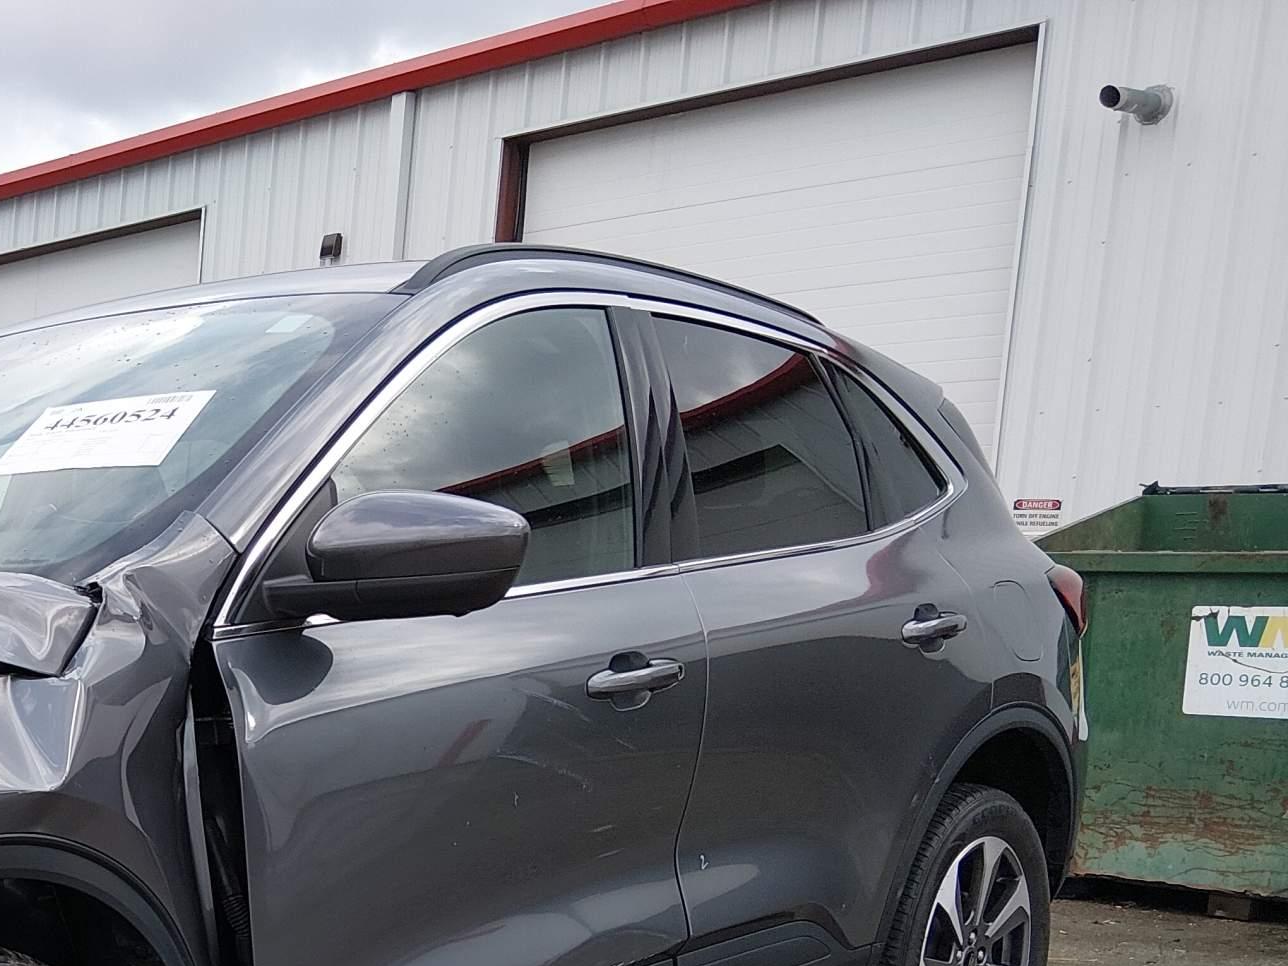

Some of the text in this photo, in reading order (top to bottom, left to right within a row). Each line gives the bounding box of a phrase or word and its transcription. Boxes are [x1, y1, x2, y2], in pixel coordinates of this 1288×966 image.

[44, 406, 180, 431] 44560524
[1207, 650, 1244, 658] WASTE
[1198, 672, 1233, 686] 800
[1238, 674, 1273, 688] 964
